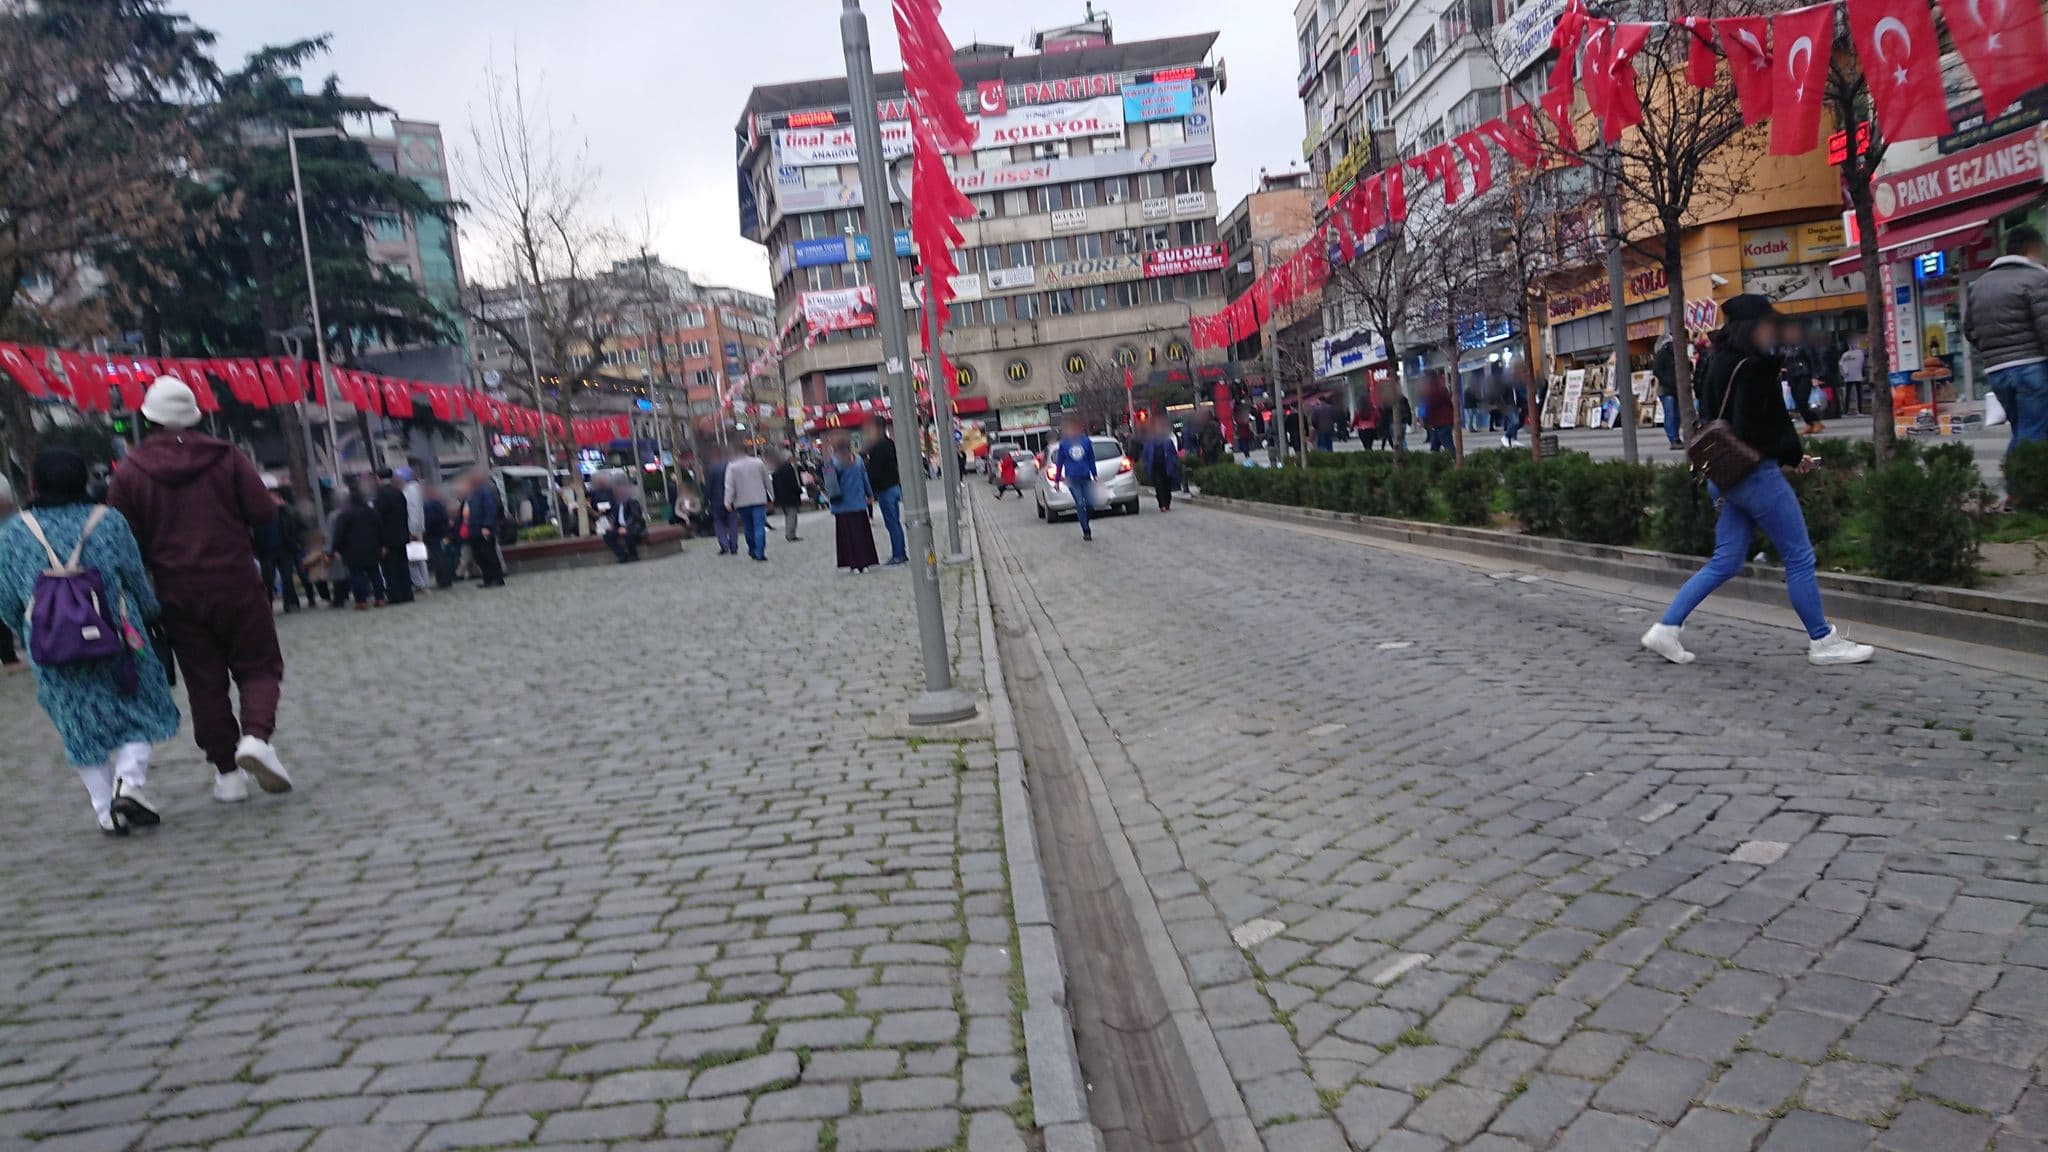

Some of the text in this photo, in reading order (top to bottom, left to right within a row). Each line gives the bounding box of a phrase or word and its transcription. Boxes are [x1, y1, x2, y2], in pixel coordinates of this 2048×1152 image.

[1896, 169, 1943, 208] PARK
[1157, 245, 1213, 263] SULDUZ
[1743, 240, 1789, 257] Kodak
